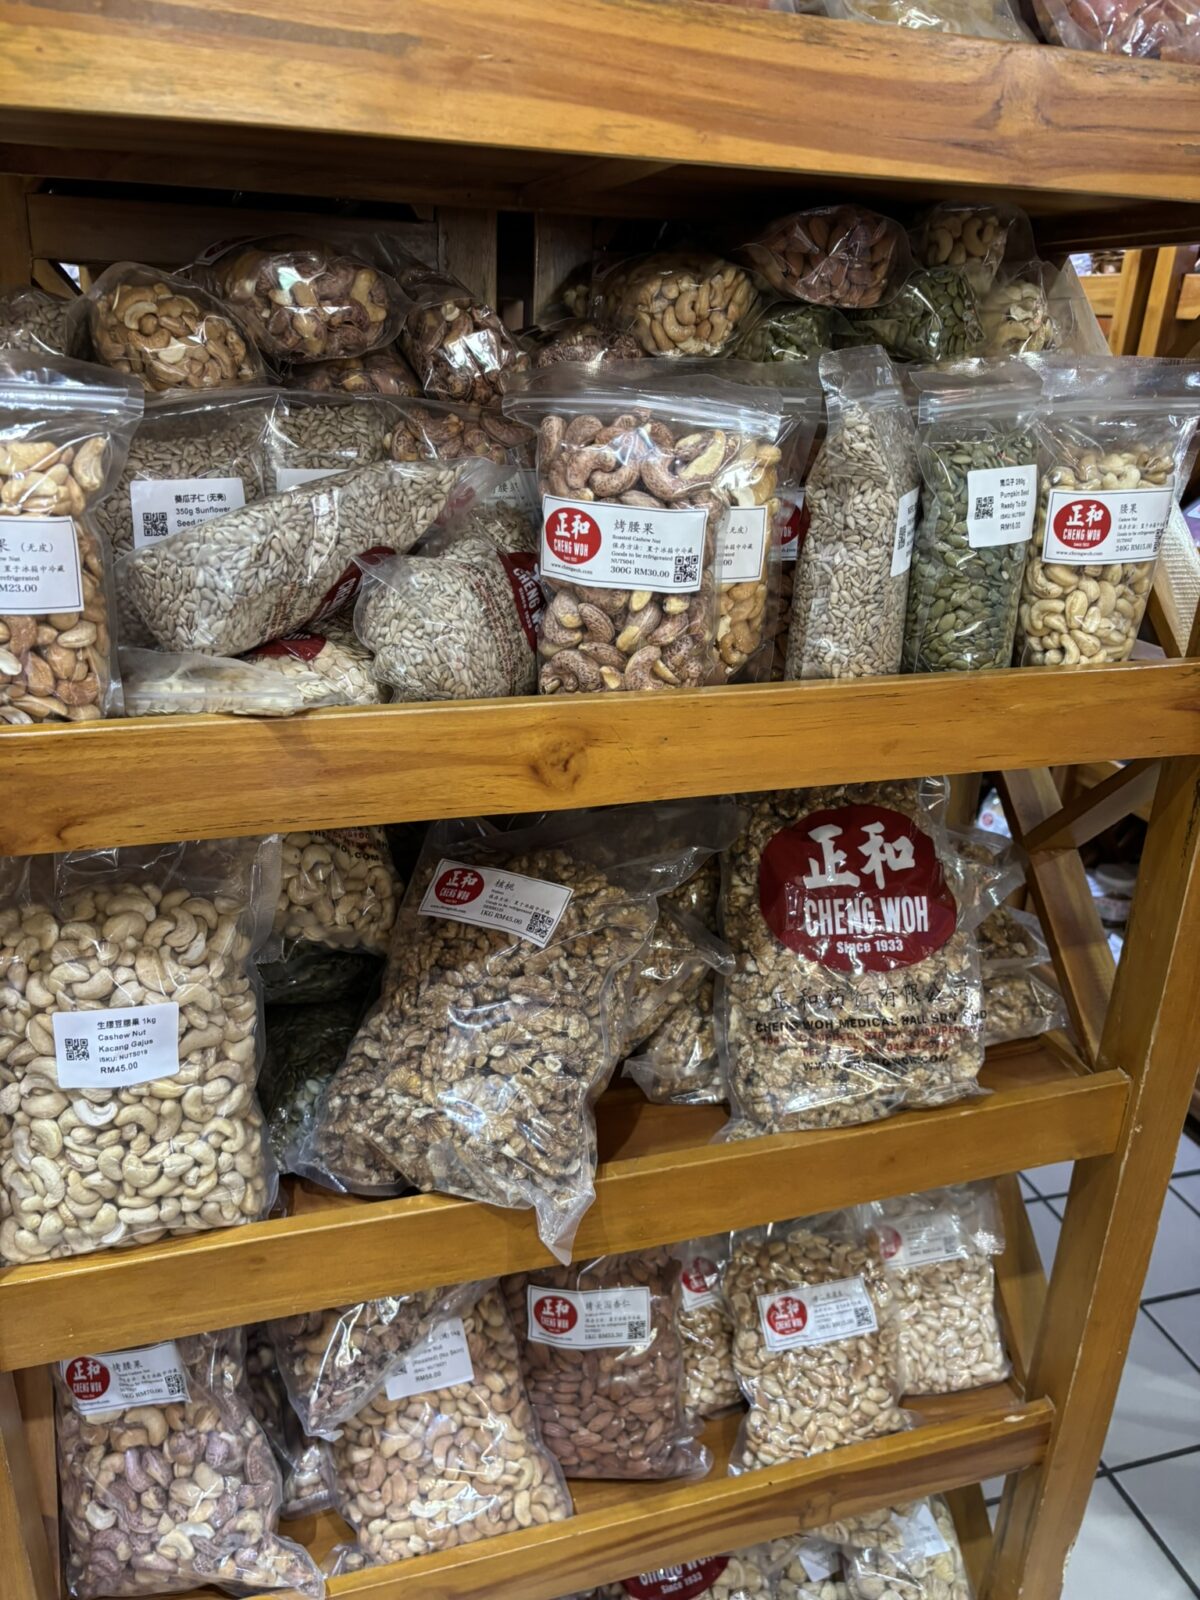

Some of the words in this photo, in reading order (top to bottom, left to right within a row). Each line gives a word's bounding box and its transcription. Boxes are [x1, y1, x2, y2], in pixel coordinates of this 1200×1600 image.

[1000, 490, 1020, 499] Pumpkin
[176, 507, 194, 516] 350g
[195, 505, 231, 515] Sunflower
[1000, 502, 1015, 510] Ready
[1066, 503, 1104, 527] 正和
[177, 519, 196, 528] Seed
[554, 512, 591, 540] 正和
[613, 518, 655, 535] 烤腰果
[1063, 528, 1086, 541] CHENG
[1086, 529, 1102, 542] WOH
[554, 538, 572, 554] CHENG
[573, 542, 589, 557] WOH
[610, 566, 632, 575] 300G
[634, 567, 670, 578] RM30.00
[0, 583, 38, 593] M23.00
[513, 567, 541, 609] CHENG
[803, 821, 915, 890] 正和
[446, 870, 478, 888] 正和
[439, 886, 457, 899] CHENG
[457, 890, 471, 901] WOH
[480, 909, 494, 917] 1KG
[494, 911, 523, 925] RM45.00
[804, 896, 877, 937] CHENG
[880, 895, 929, 933] WOH
[836, 940, 871, 954] Since
[874, 939, 904, 953] 1933
[142, 1016, 157, 1025] 1kg
[805, 1018, 833, 1031] WOH
[838, 1016, 897, 1030] MEDICAL
[901, 1014, 927, 1026] HALL
[930, 1011, 958, 1024] SDN
[97, 1032, 131, 1042] Cashew
[132, 1029, 147, 1037] Nut
[98, 1040, 129, 1053] Kacang
[130, 1038, 154, 1048] Gajus
[100, 1061, 138, 1074] RM45.00
[542, 1299, 570, 1318] 正和
[774, 1300, 799, 1319] 正和
[541, 1315, 557, 1327] CHENG
[557, 1318, 569, 1329] WOH
[775, 1320, 792, 1330] CHENG
[792, 1318, 803, 1328] WOH
[73, 1360, 100, 1380] 正和
[73, 1382, 90, 1393] CHENG
[90, 1381, 102, 1393] WOH
[661, 1582, 683, 1594] Since
